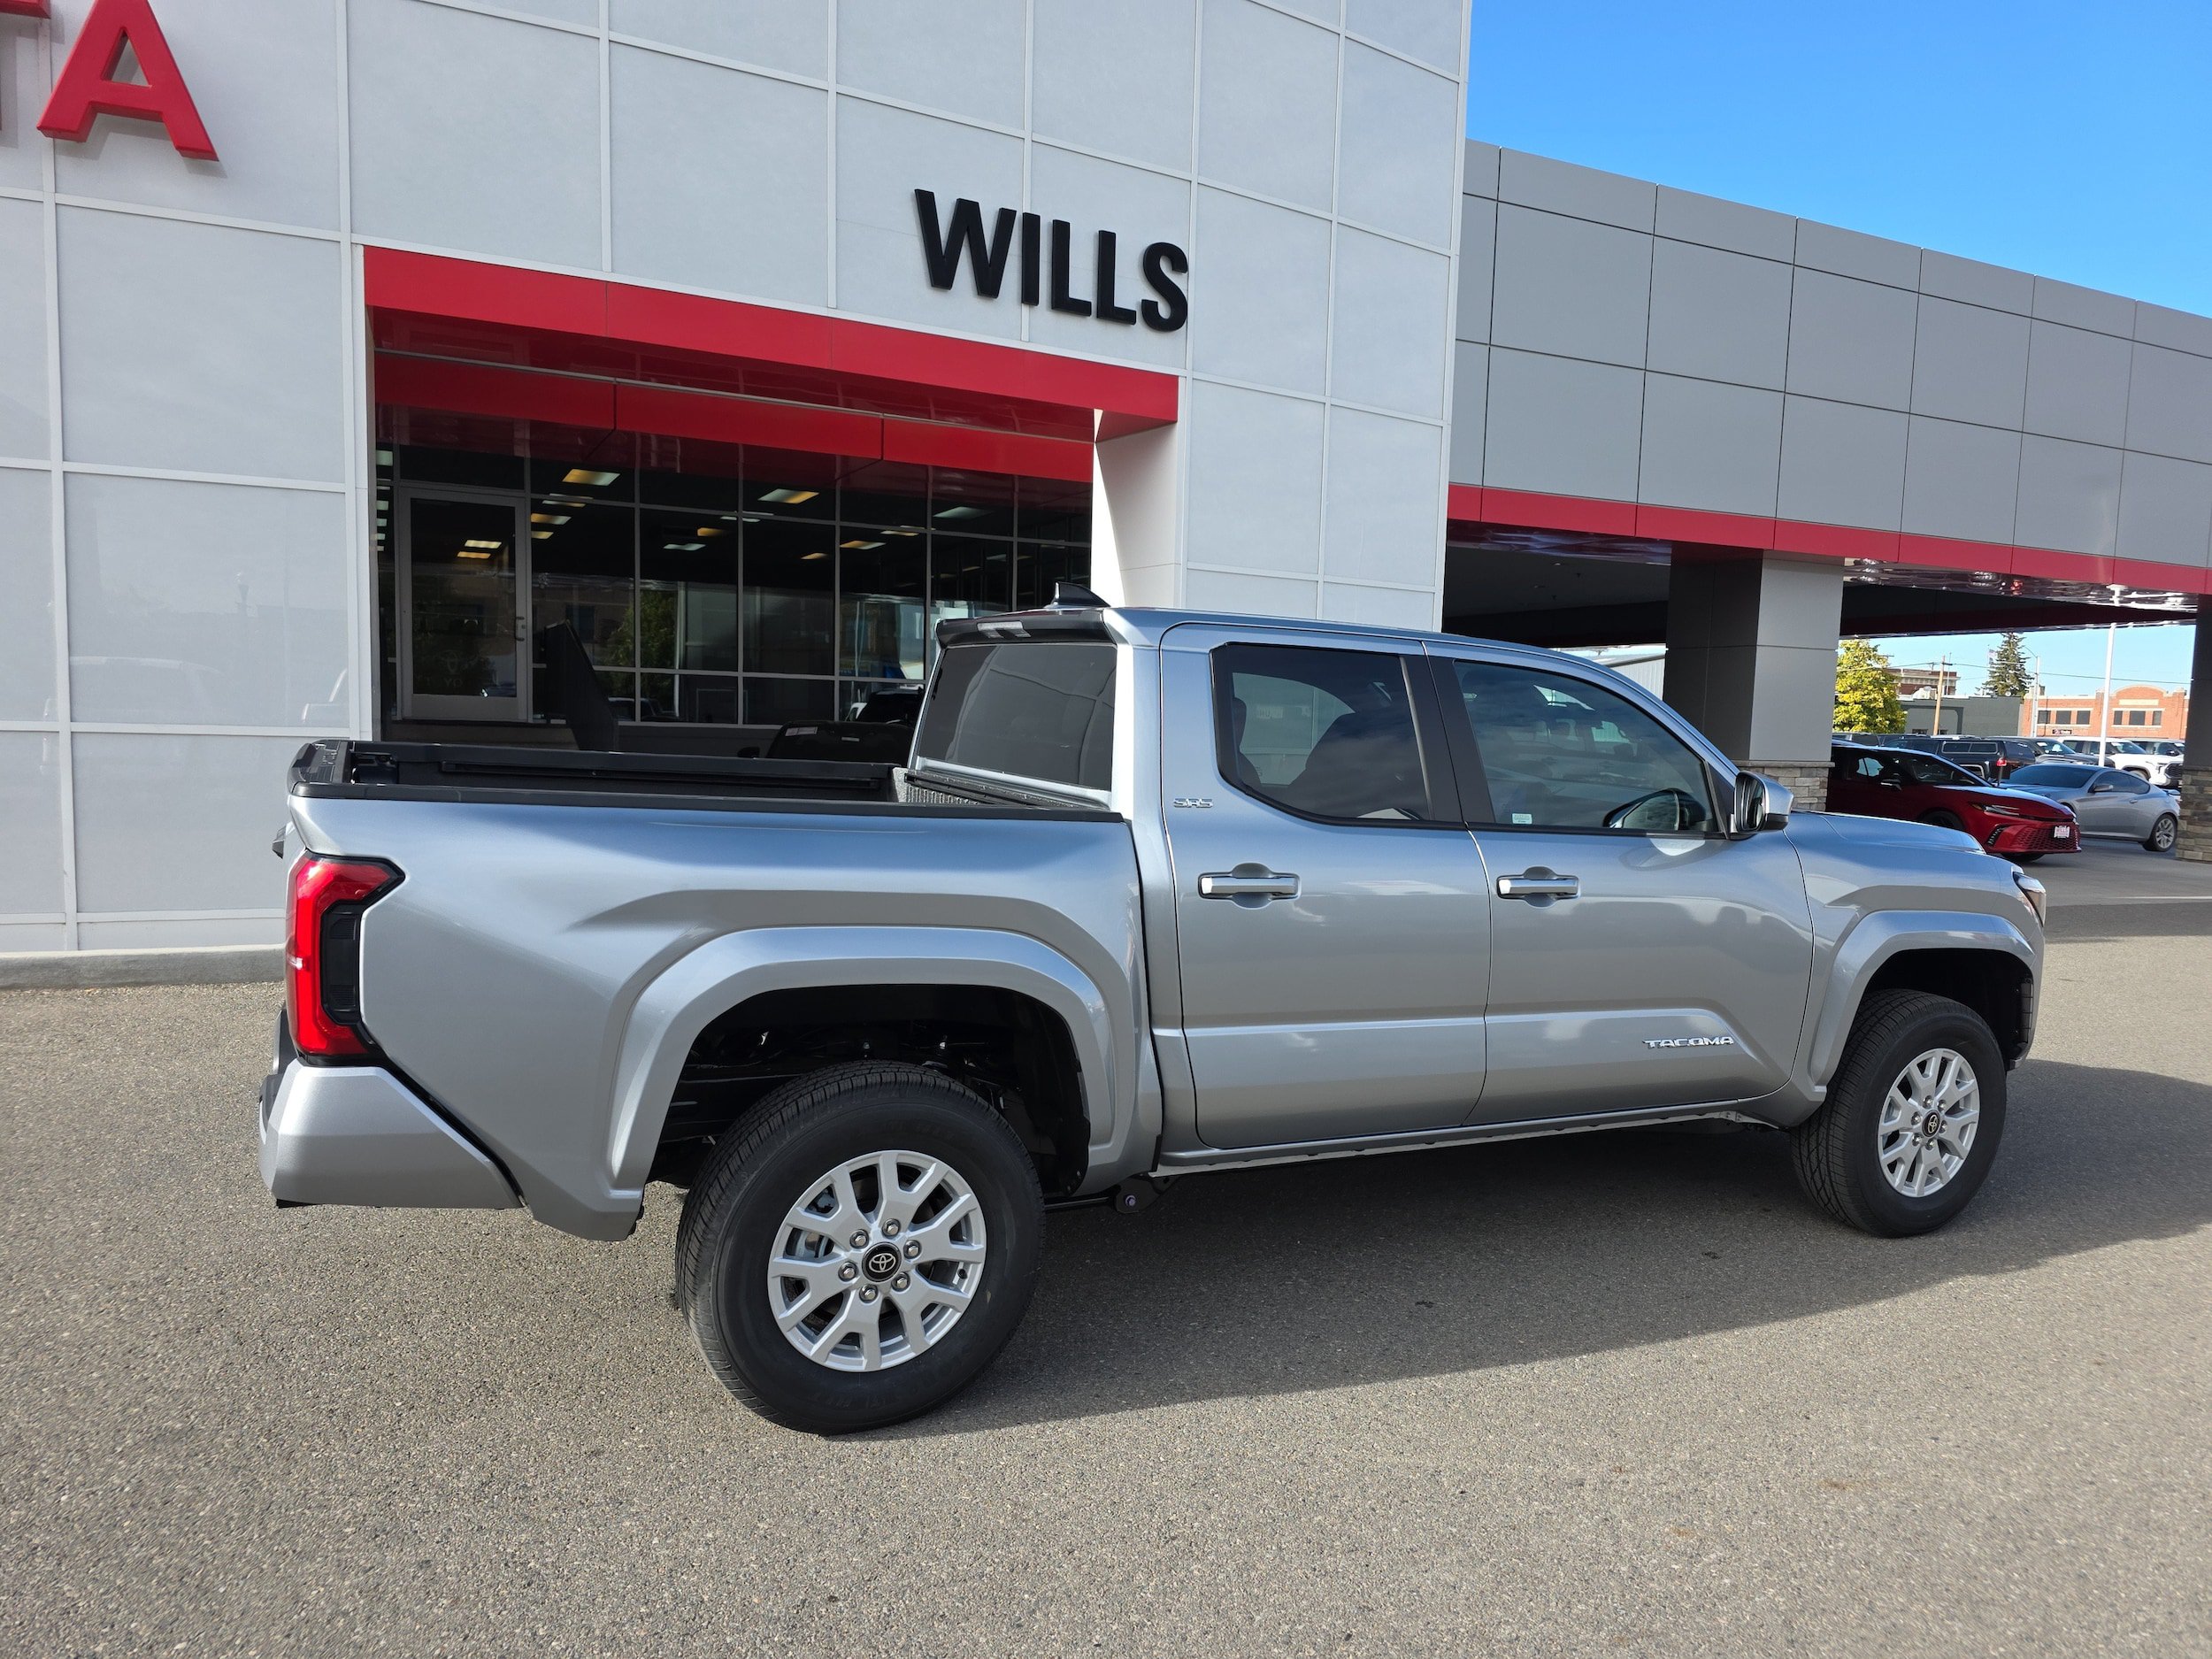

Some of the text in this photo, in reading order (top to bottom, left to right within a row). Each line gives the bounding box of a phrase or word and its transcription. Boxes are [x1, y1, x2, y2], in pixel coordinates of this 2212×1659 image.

[0, 0, 219, 162] A
[914, 188, 1188, 332] WILLS
[1173, 798, 1213, 808] SR5
[1643, 1036, 1734, 1048] TACOMA
